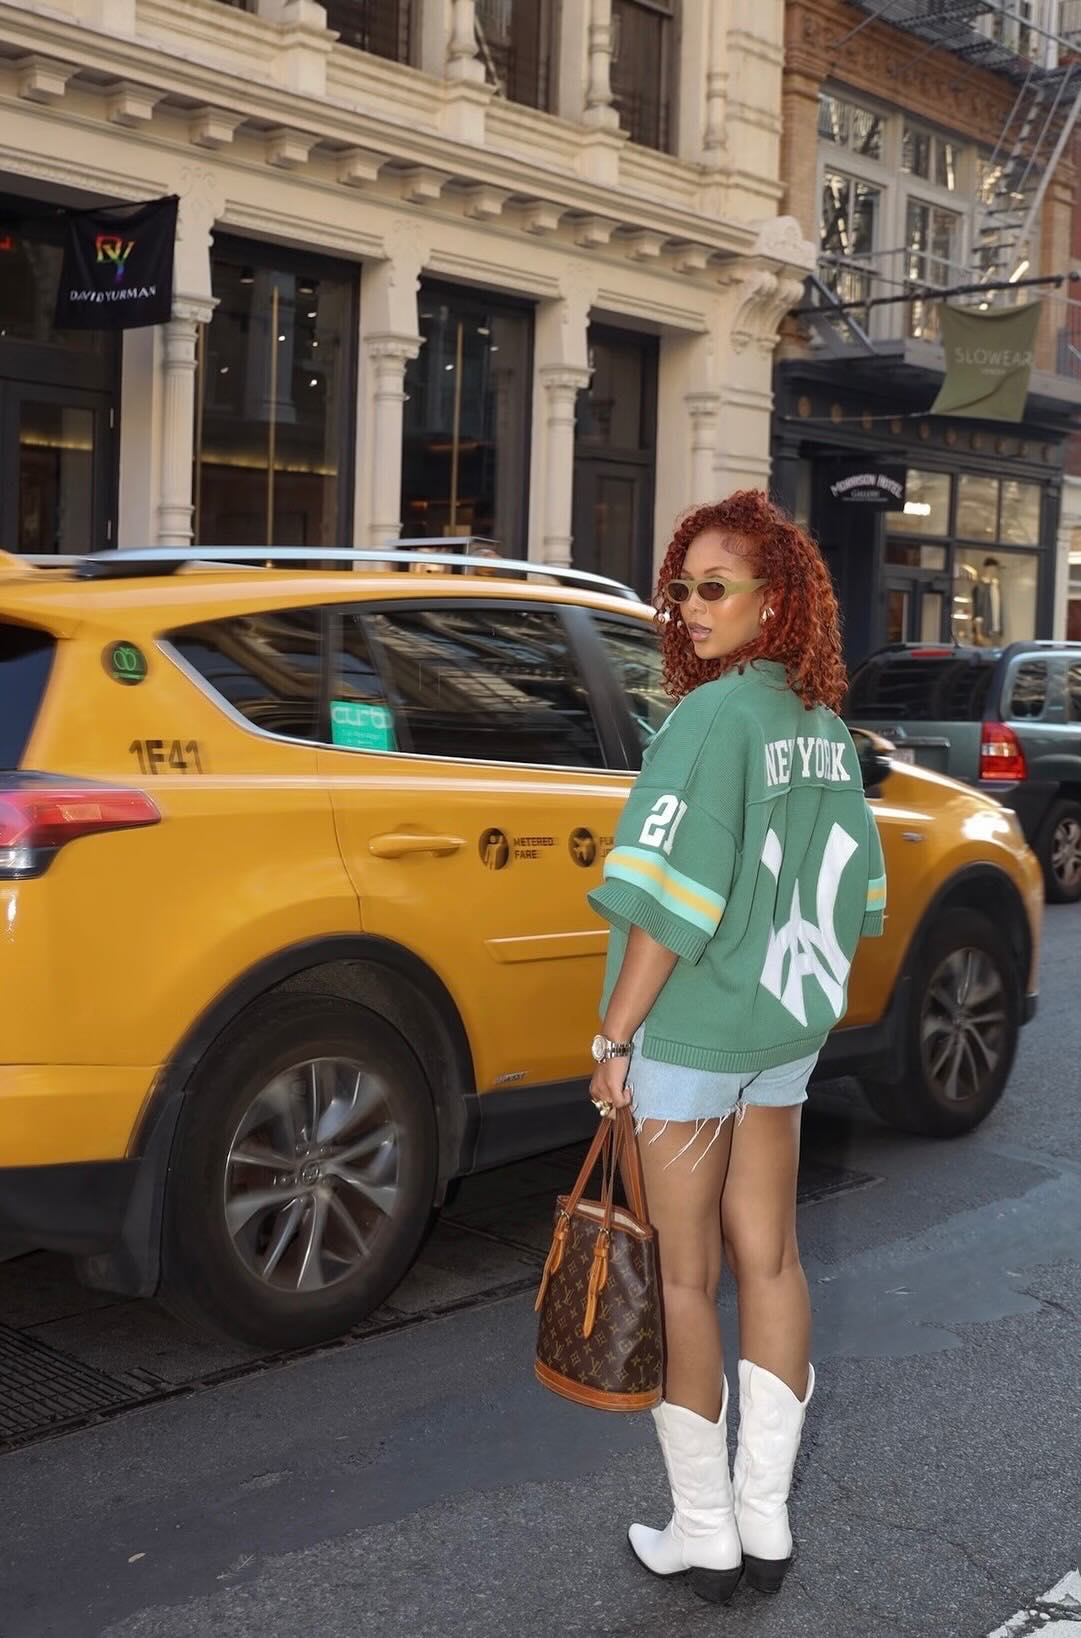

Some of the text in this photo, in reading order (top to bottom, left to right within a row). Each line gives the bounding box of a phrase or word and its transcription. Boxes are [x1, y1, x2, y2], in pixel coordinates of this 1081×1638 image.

[69, 285, 157, 303] DAVID YURMAN
[955, 346, 1034, 367] SLOWEAR
[877, 474, 904, 499] HOTEL
[128, 739, 205, 775] 1F41
[796, 736, 851, 782] YORK
[638, 794, 688, 856] 21
[513, 837, 555, 847] METERED
[514, 850, 538, 860] FARE
